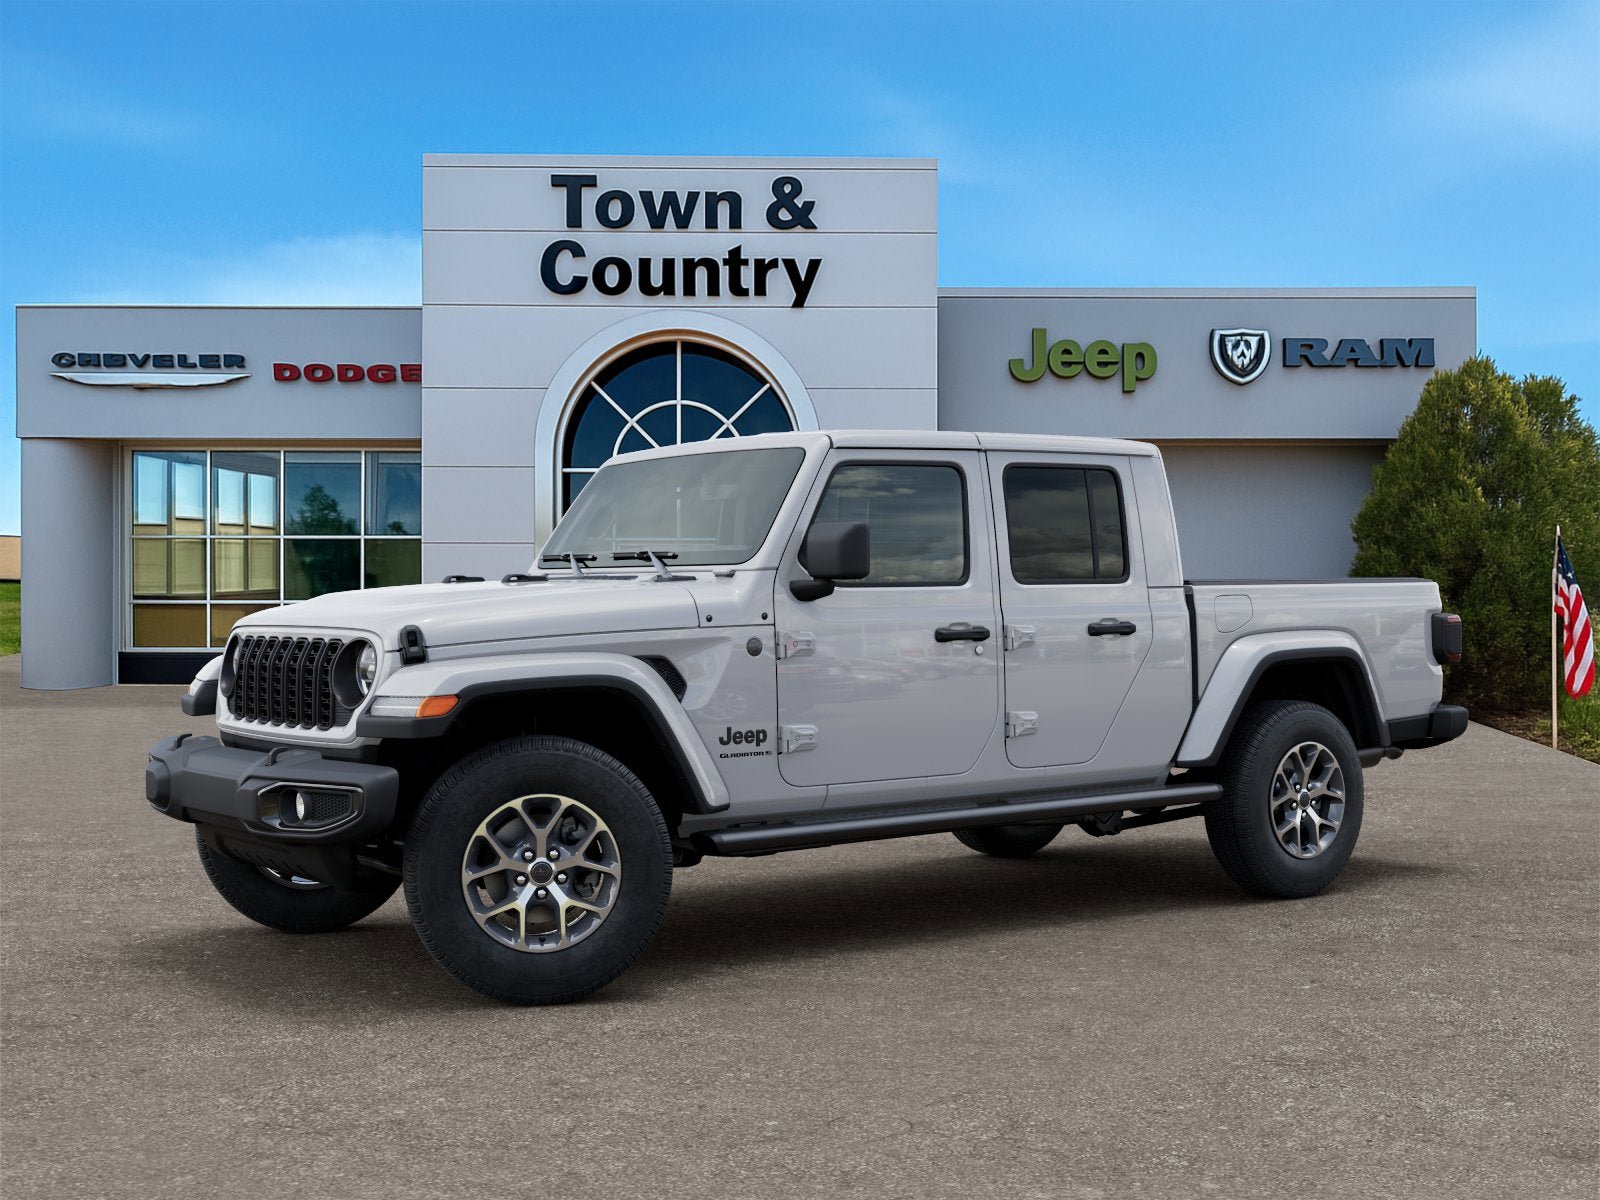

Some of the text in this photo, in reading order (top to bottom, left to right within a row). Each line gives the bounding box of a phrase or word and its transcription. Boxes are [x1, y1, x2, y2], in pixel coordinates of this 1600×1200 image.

[551, 174, 818, 230] Town &
[540, 239, 823, 308] Country
[273, 362, 422, 383] DODGE
[1008, 328, 1158, 393] Jeep
[1282, 337, 1436, 368] RAM
[718, 726, 768, 747] Jeep
